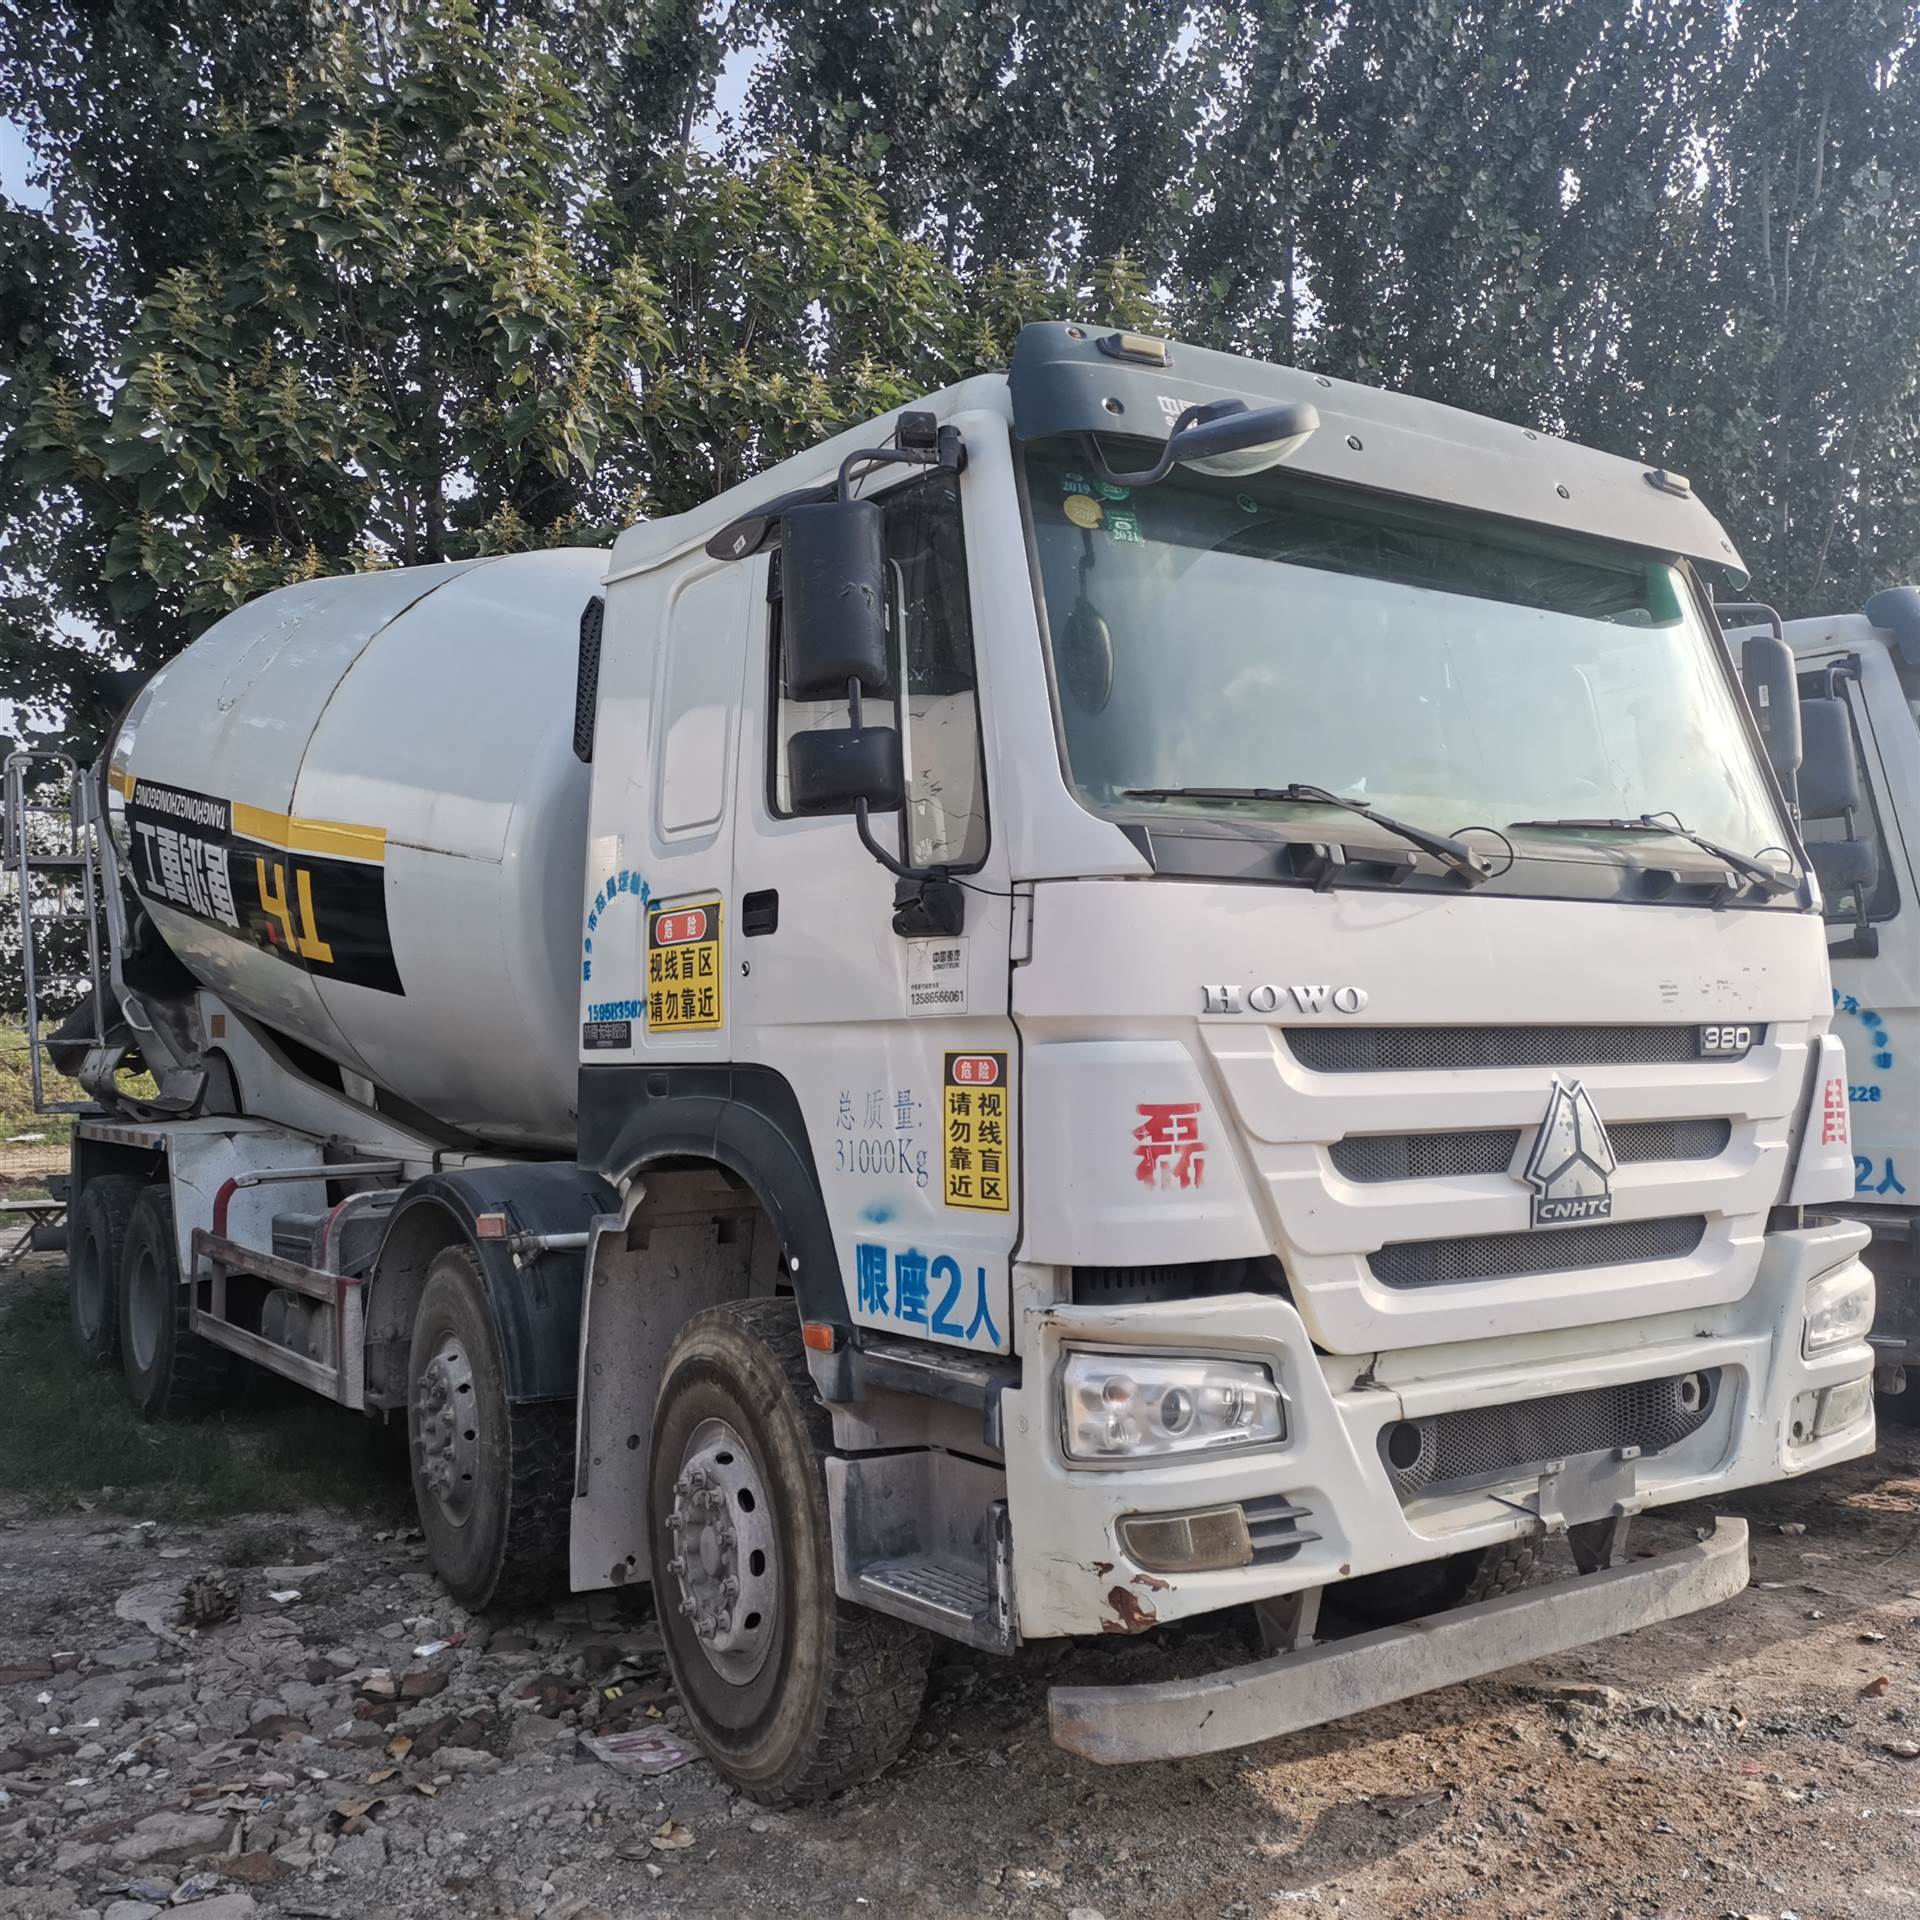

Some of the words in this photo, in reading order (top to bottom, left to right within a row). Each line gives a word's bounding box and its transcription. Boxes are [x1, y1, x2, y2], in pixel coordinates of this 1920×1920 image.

[1063, 481, 1090, 494] 2019
[135, 784, 227, 830] TANGHONGZHONGGONG
[135, 821, 240, 929] 唐鸿重工
[664, 915, 697, 941] 危险
[649, 946, 714, 983] 视线盲区
[649, 986, 714, 1023] 请勿靠近
[911, 989, 964, 1006] 13586566061
[1202, 983, 1369, 1014] HOWO
[1705, 1026, 1751, 1049] 380
[960, 1061, 991, 1081] 危险
[835, 1137, 929, 1189] 31000Kg
[948, 1091, 973, 1199] 请勿靠近
[978, 1092, 1003, 1201] 视线盲区
[1540, 1198, 1610, 1219] CNHTC
[856, 1242, 1002, 1350] 限座2人
